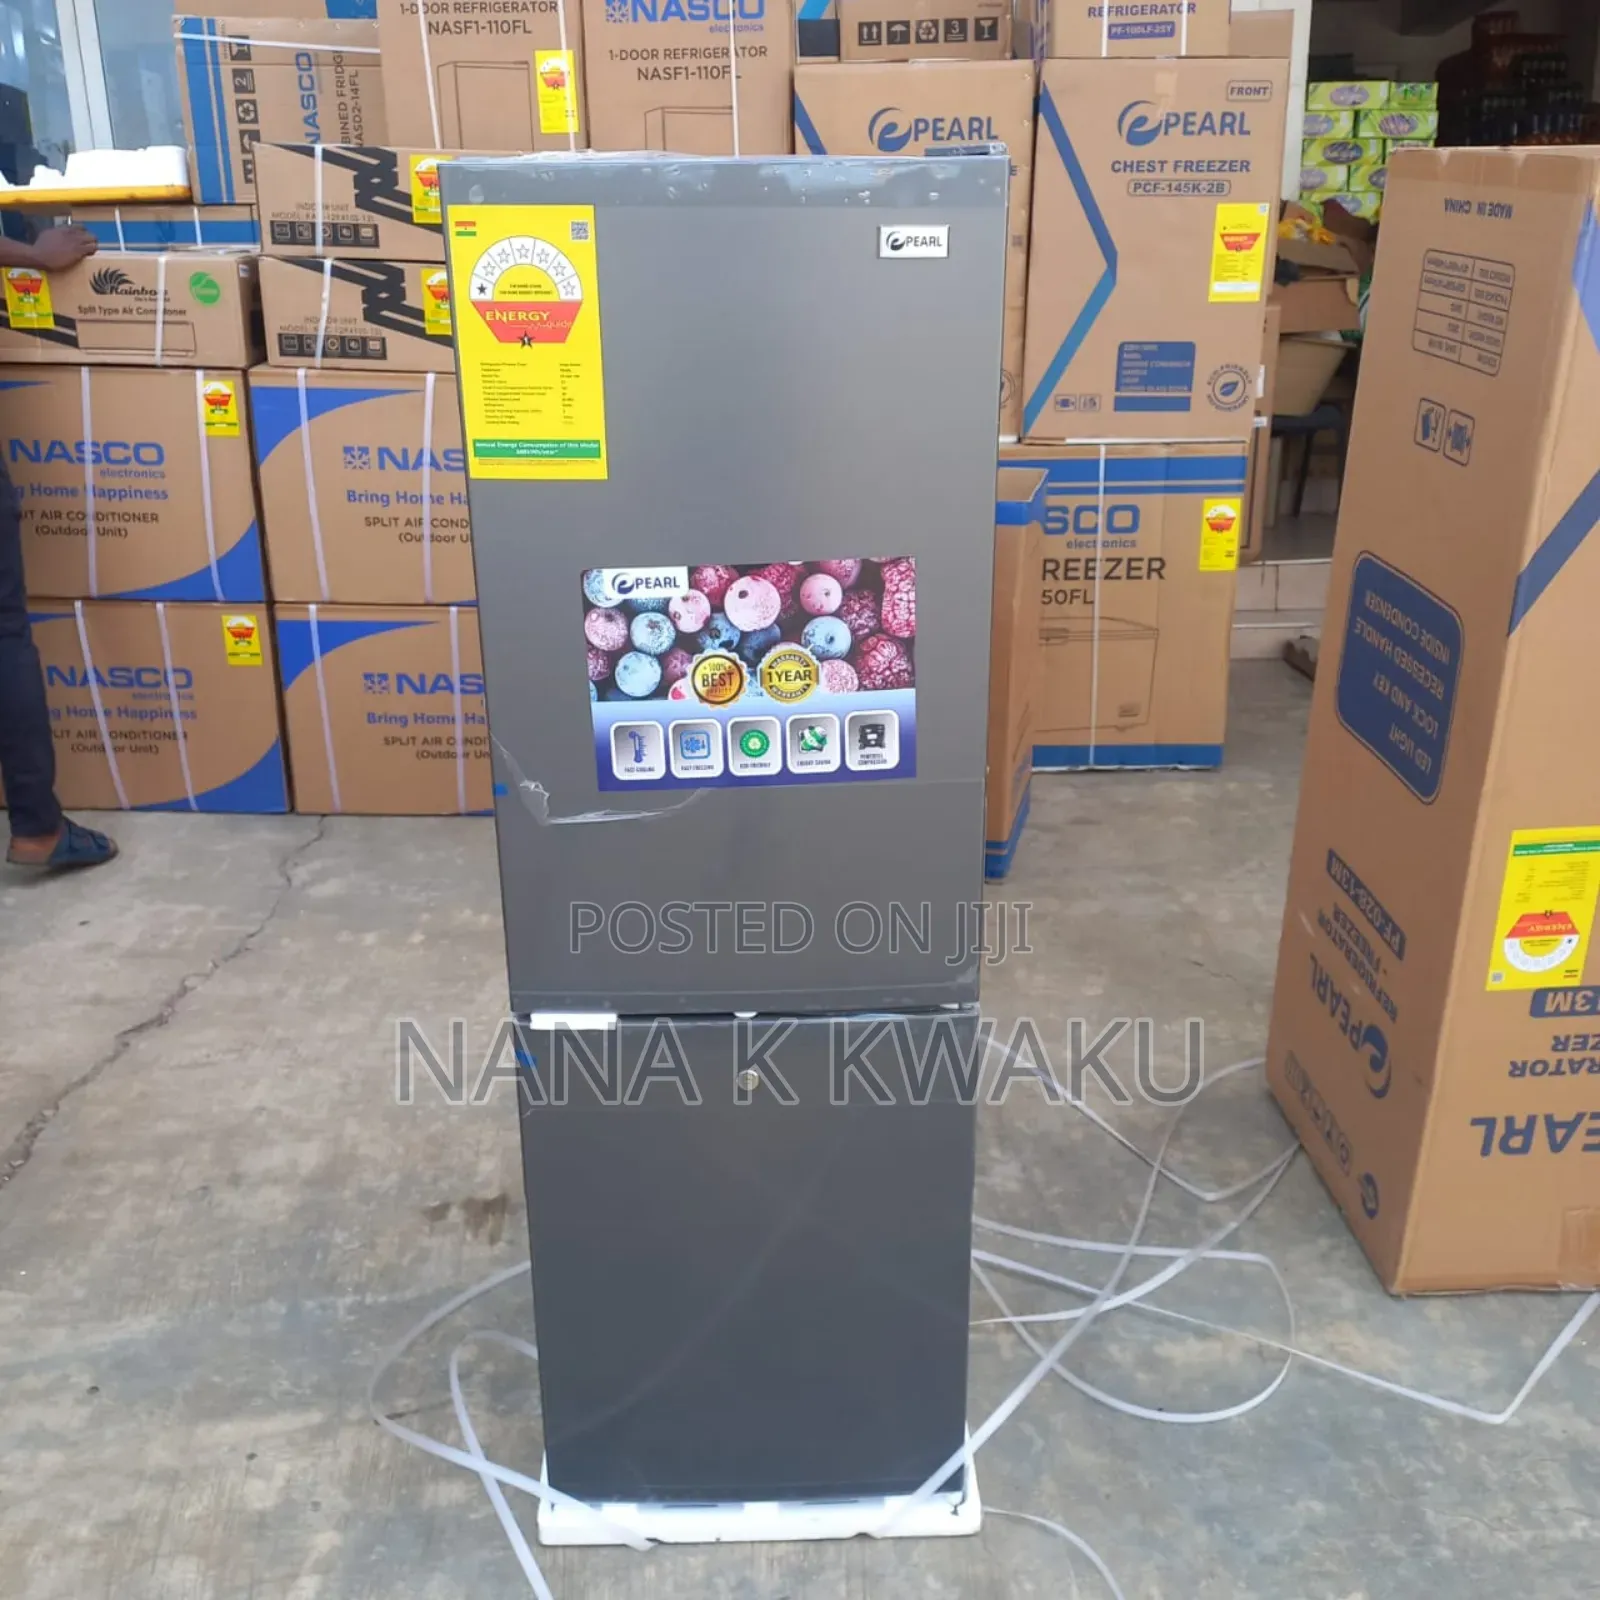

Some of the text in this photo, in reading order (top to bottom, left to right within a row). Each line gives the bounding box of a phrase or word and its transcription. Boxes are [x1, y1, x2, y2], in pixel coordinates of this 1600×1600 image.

[400, 1, 558, 14] 1-DOOR REFRIGERATOR
[1088, 3, 1196, 18] REFRIGERATOR
[428, 20, 533, 35] NASF1-110FL
[609, 49, 659, 61] 1-DOOR
[637, 65, 743, 81] NASF1-110F
[1230, 86, 1269, 97] FRONT
[1111, 159, 1251, 174] CHEST FREEZER
[1133, 182, 1225, 194] PCF-145K-2B
[110, 284, 168, 296] Rainbo
[485, 309, 550, 324] ENERGY
[9, 439, 165, 466] NASCO
[100, 468, 166, 479] electronics
[30, 482, 79, 498] Home
[346, 490, 390, 507] Bring
[40, 511, 62, 521] AIR
[66, 510, 159, 523] CODITIONER
[364, 516, 399, 527] SPLIT
[35, 525, 128, 539] (Outdoo Unit)
[1066, 538, 1137, 549] electonics
[46, 665, 194, 689] NASCO
[701, 671, 734, 688] BEST
[767, 669, 812, 683] 1 YEAR
[366, 711, 409, 728] Bring
[383, 736, 417, 746] SPLIT
[421, 736, 443, 746] AIR
[1310, 950, 1364, 1051] PEARL
